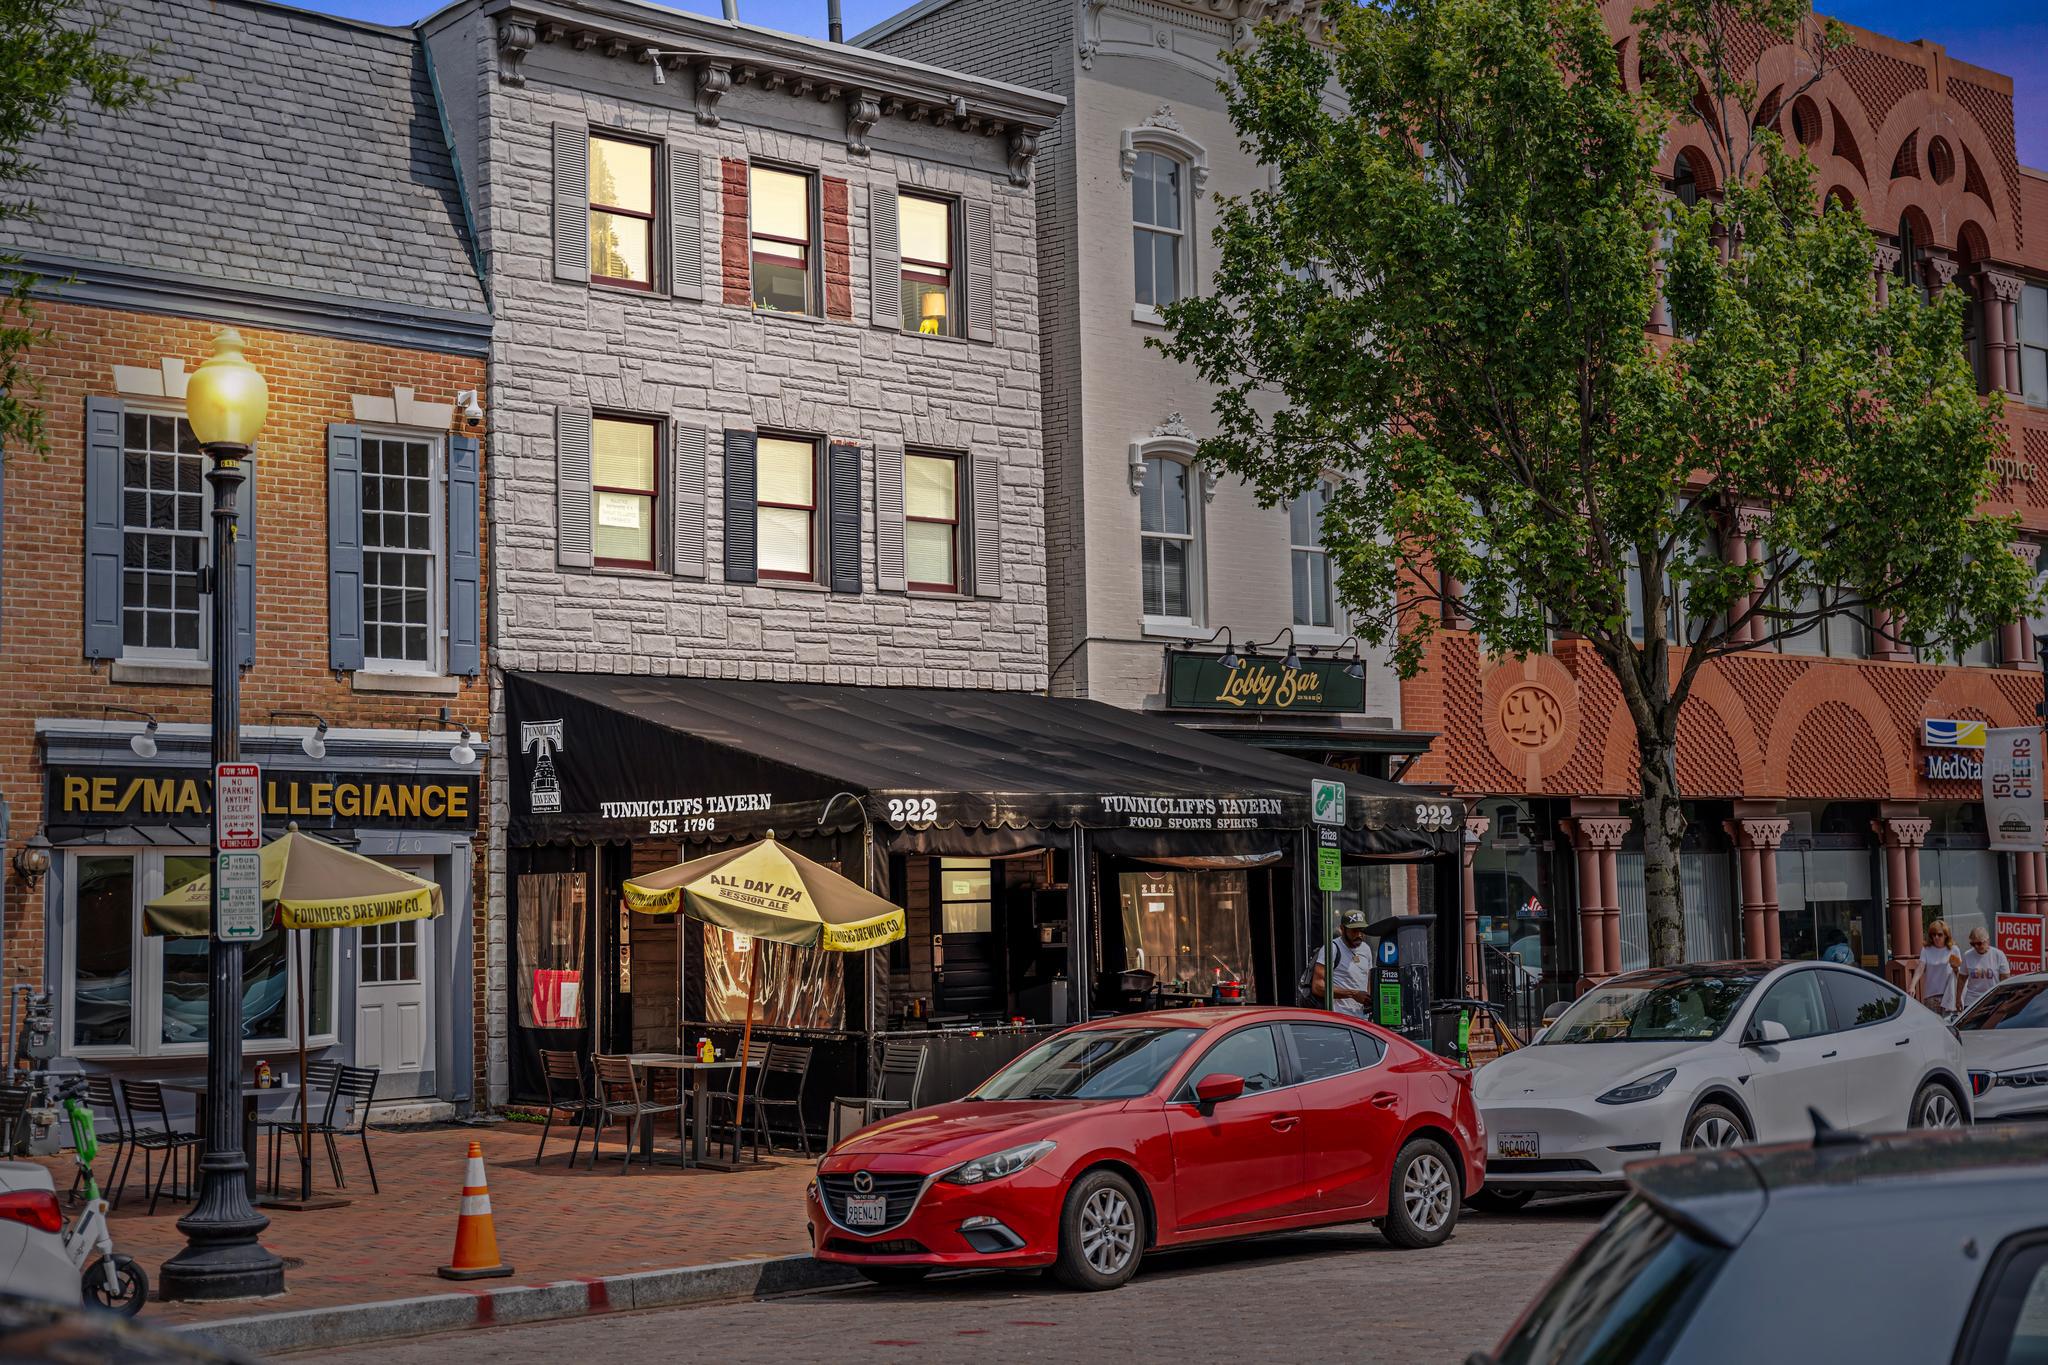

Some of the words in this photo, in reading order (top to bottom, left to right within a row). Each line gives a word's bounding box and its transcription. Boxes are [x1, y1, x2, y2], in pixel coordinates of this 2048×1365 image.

[1988, 457, 2037, 487] ospice
[1216, 658, 1277, 706] Lobby
[1275, 665, 1319, 708] Bar
[223, 767, 236, 776] TOW
[1928, 754, 1983, 780] MedSta
[2013, 738, 2032, 798] CHEERS
[63, 776, 212, 813] RE/MA
[261, 781, 469, 817] LLEGIANCE
[222, 787, 254, 795] PARKING
[1336, 787, 1342, 799] 2
[1993, 774, 2011, 799] 150
[224, 796, 252, 804] ANYTIME
[533, 794, 558, 804] TAVERN
[600, 797, 704, 819] TUNNICLIFFS
[706, 793, 772, 814] TAVERN
[1101, 796, 1216, 815] TUNNICLIFFS
[1218, 799, 1282, 815] TAVERN
[888, 798, 938, 822] 222
[1415, 804, 1453, 825] 222
[649, 819, 679, 834] EST.
[684, 817, 716, 833] 1796
[1129, 816, 1162, 828] FOOD
[1168, 817, 1211, 829] SPORTS
[1217, 817, 1258, 829] SPIRITS
[222, 857, 229, 868] 2
[185, 882, 209, 893] AL
[711, 874, 740, 888] ALL
[744, 878, 774, 895] DAY
[777, 885, 803, 903] IPA
[719, 889, 765, 905] SESSION
[767, 899, 789, 912] ALE
[293, 903, 352, 923] FOUNDERS
[353, 901, 403, 920] BREWING
[404, 900, 423, 914] CO.
[1998, 921, 2041, 936] URGENT
[1384, 942, 1396, 963] P
[2005, 939, 2033, 952] CARE
[2009, 960, 2030, 972] NICA
[2030, 962, 2041, 972] DE
